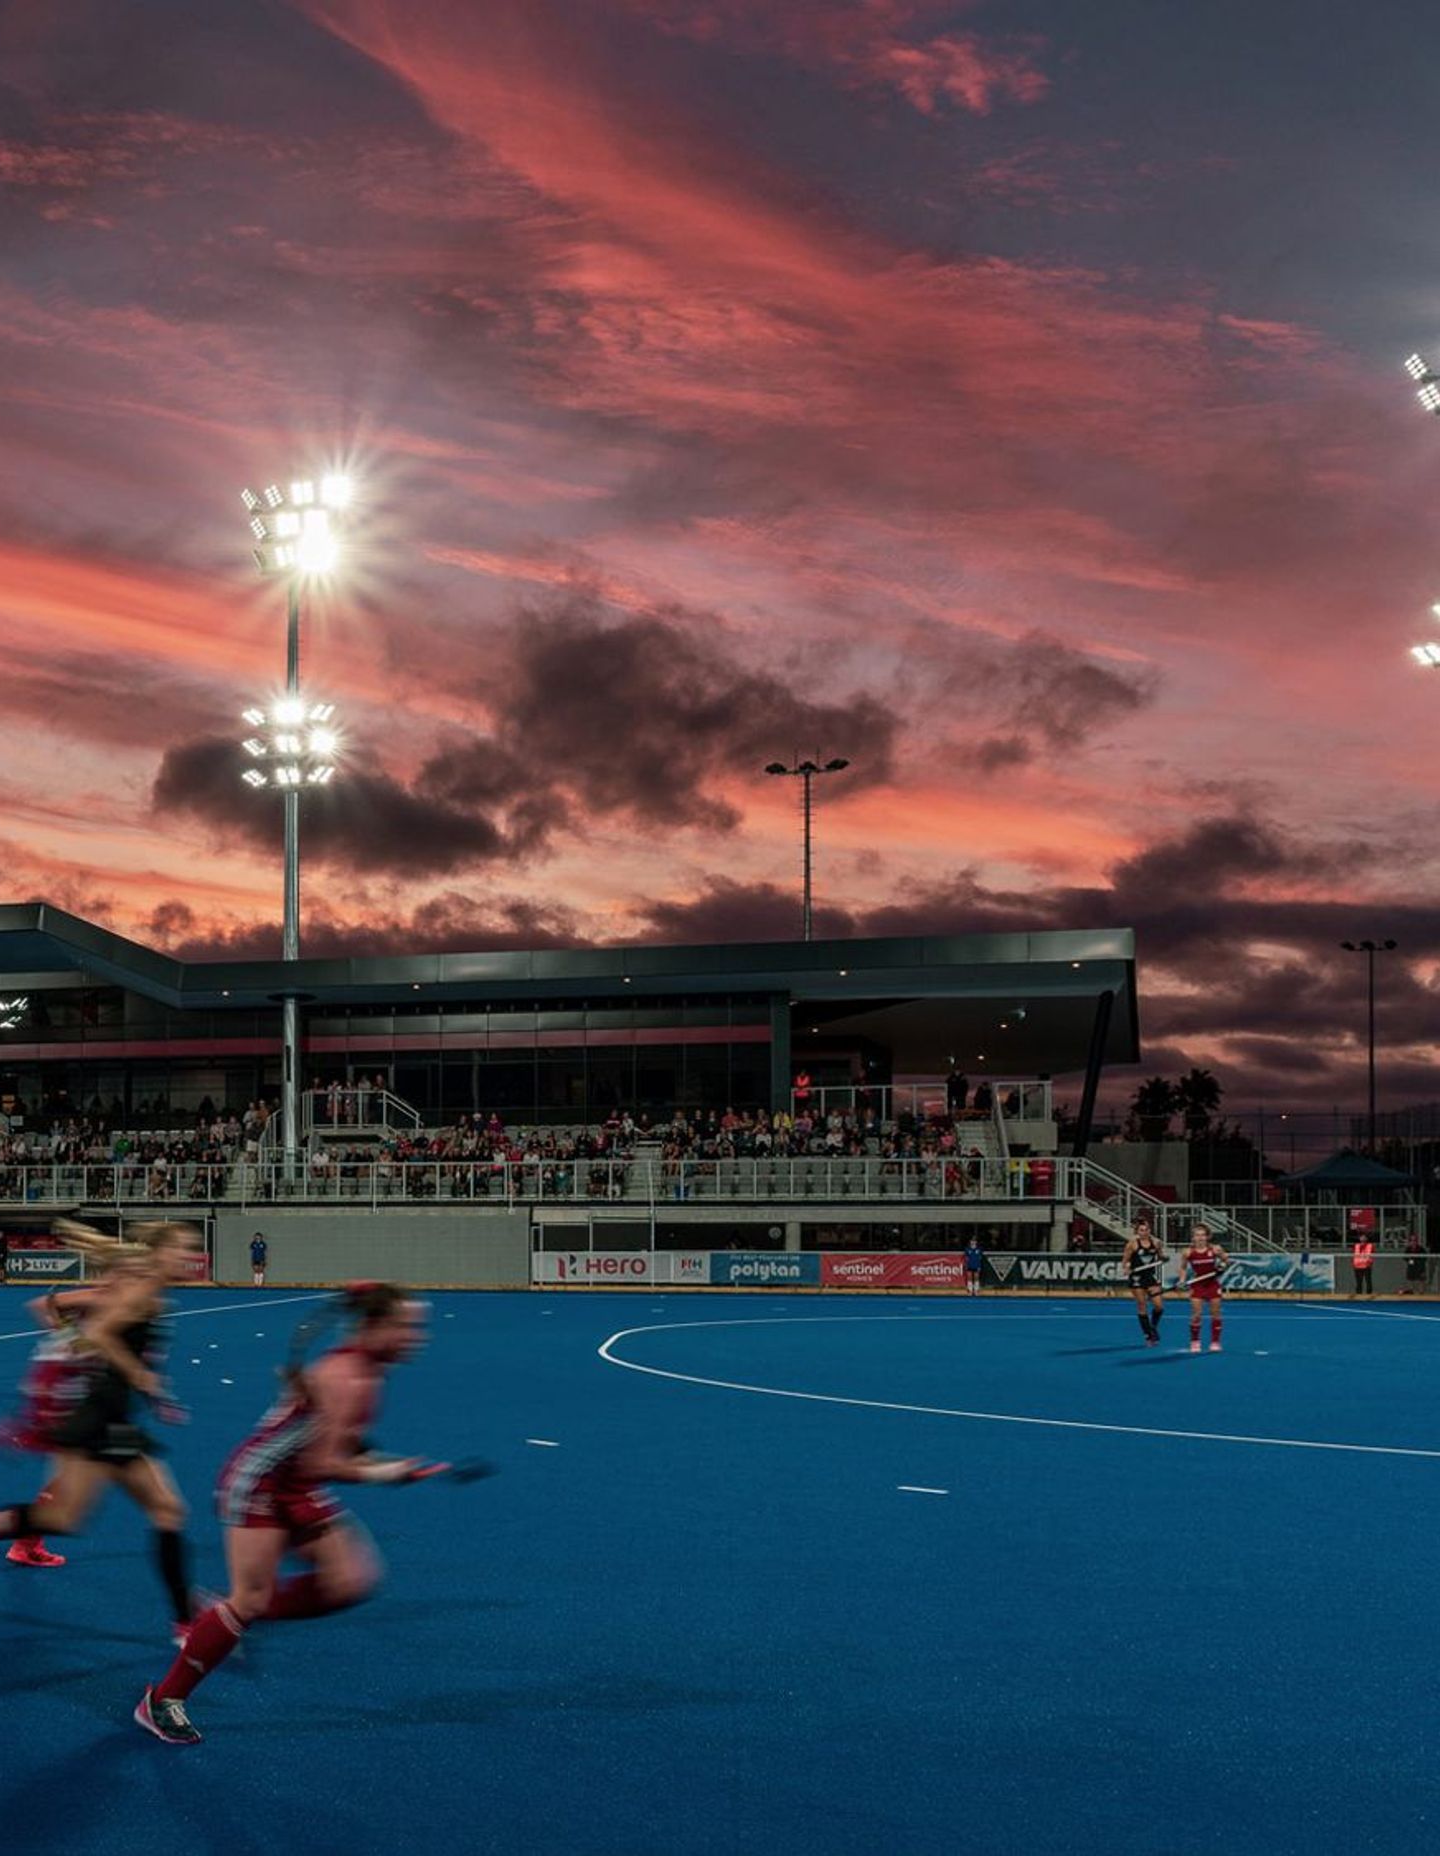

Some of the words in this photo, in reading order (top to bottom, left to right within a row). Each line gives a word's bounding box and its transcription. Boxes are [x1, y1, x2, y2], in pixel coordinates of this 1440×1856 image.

[33, 1260, 57, 1270] LIVE
[730, 1262, 800, 1280] polytan
[832, 1263, 884, 1275] sentinel
[911, 1263, 963, 1275] sentinel
[1020, 1260, 1130, 1280] VANTAGE
